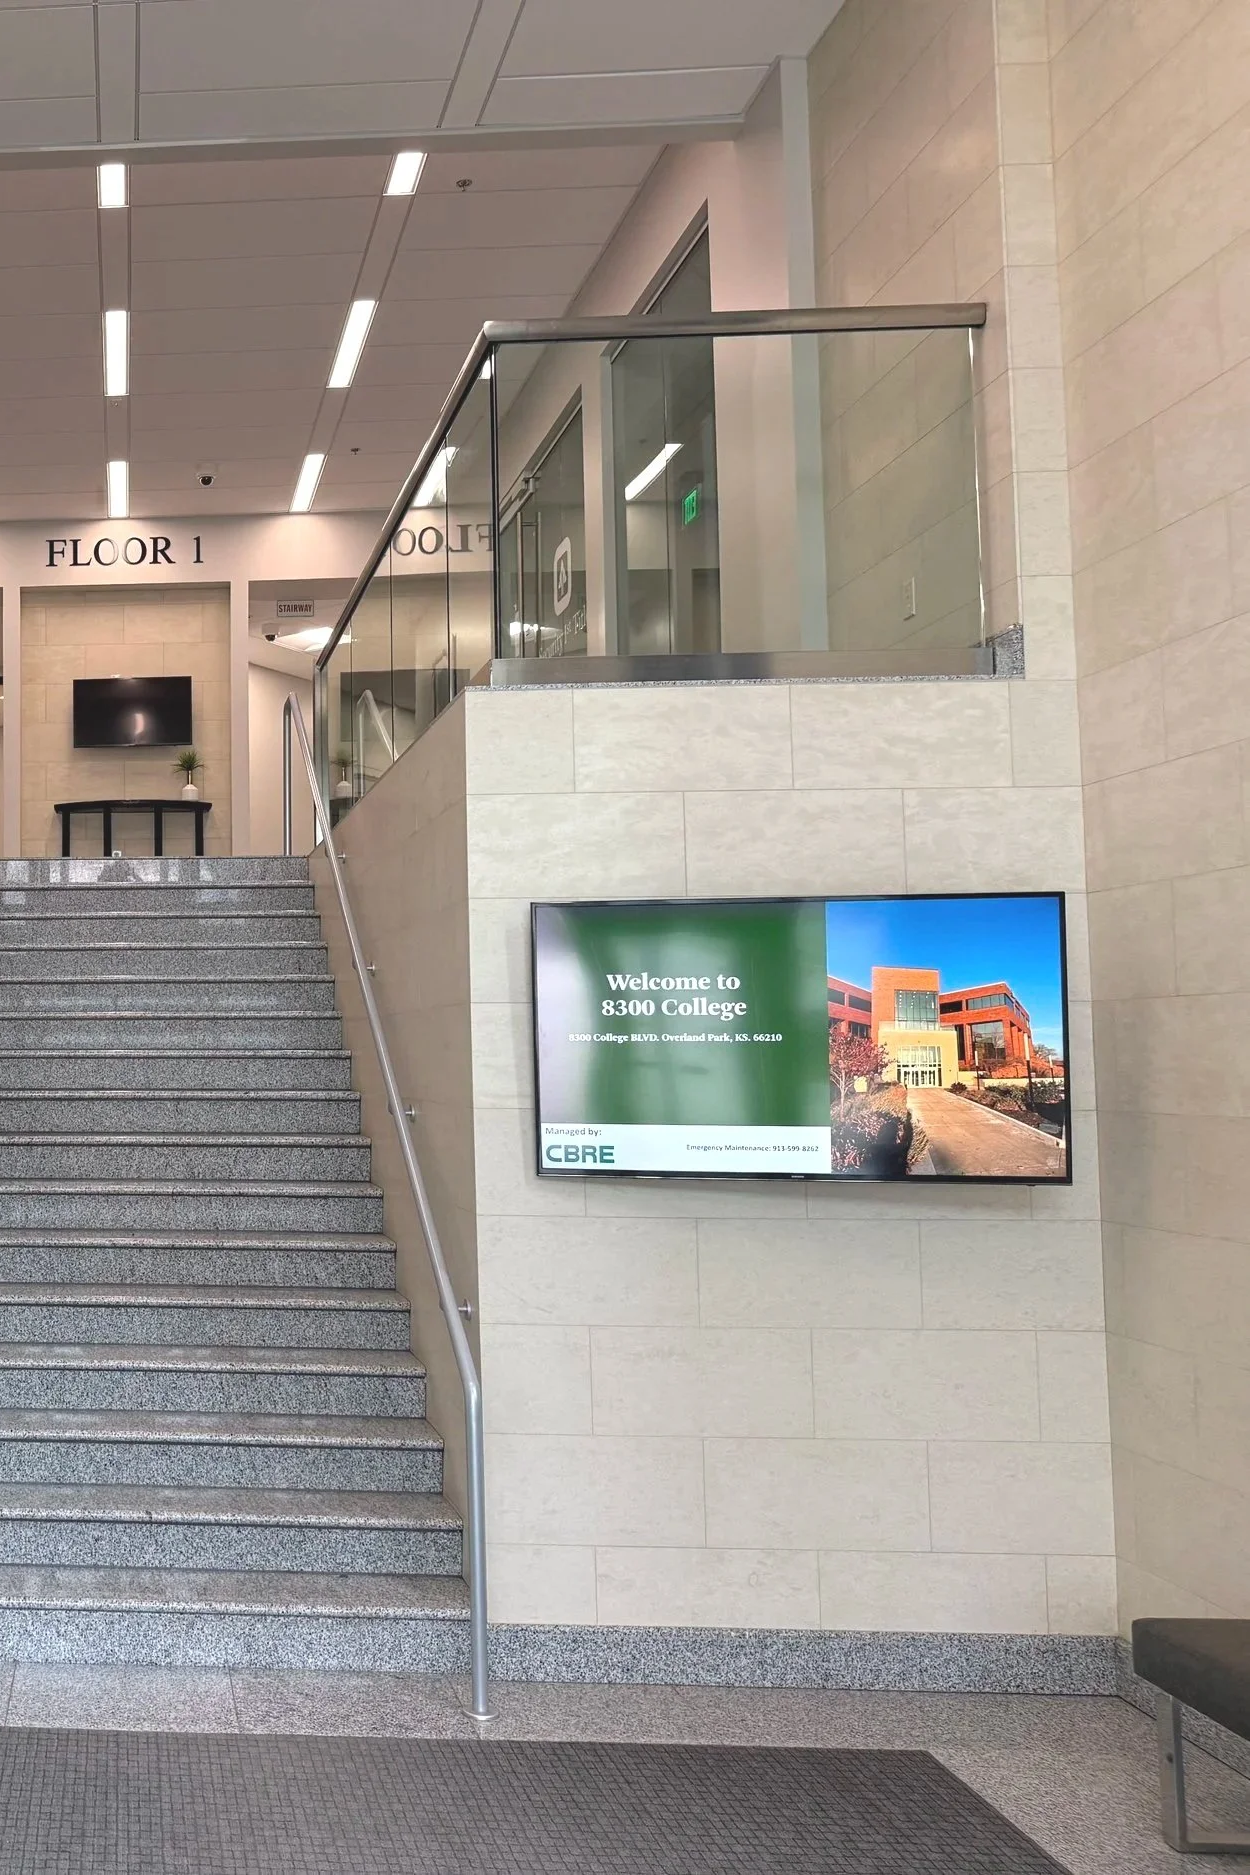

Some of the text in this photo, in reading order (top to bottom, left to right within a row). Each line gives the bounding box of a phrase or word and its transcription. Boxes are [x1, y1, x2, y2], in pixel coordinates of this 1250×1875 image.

[45, 535, 204, 567] FLOOR 1
[278, 604, 313, 613] STAIRWAY
[606, 972, 741, 991] Welcome to
[601, 997, 747, 1021] 8300 College
[568, 1033, 783, 1044] 8300 College BLVD. Overland Park, KS. 66210
[545, 1127, 602, 1137] Managed by:
[545, 1144, 615, 1164] CBRE
[686, 1144, 723, 1152] Emergency
[724, 1144, 772, 1152] Maintenance:
